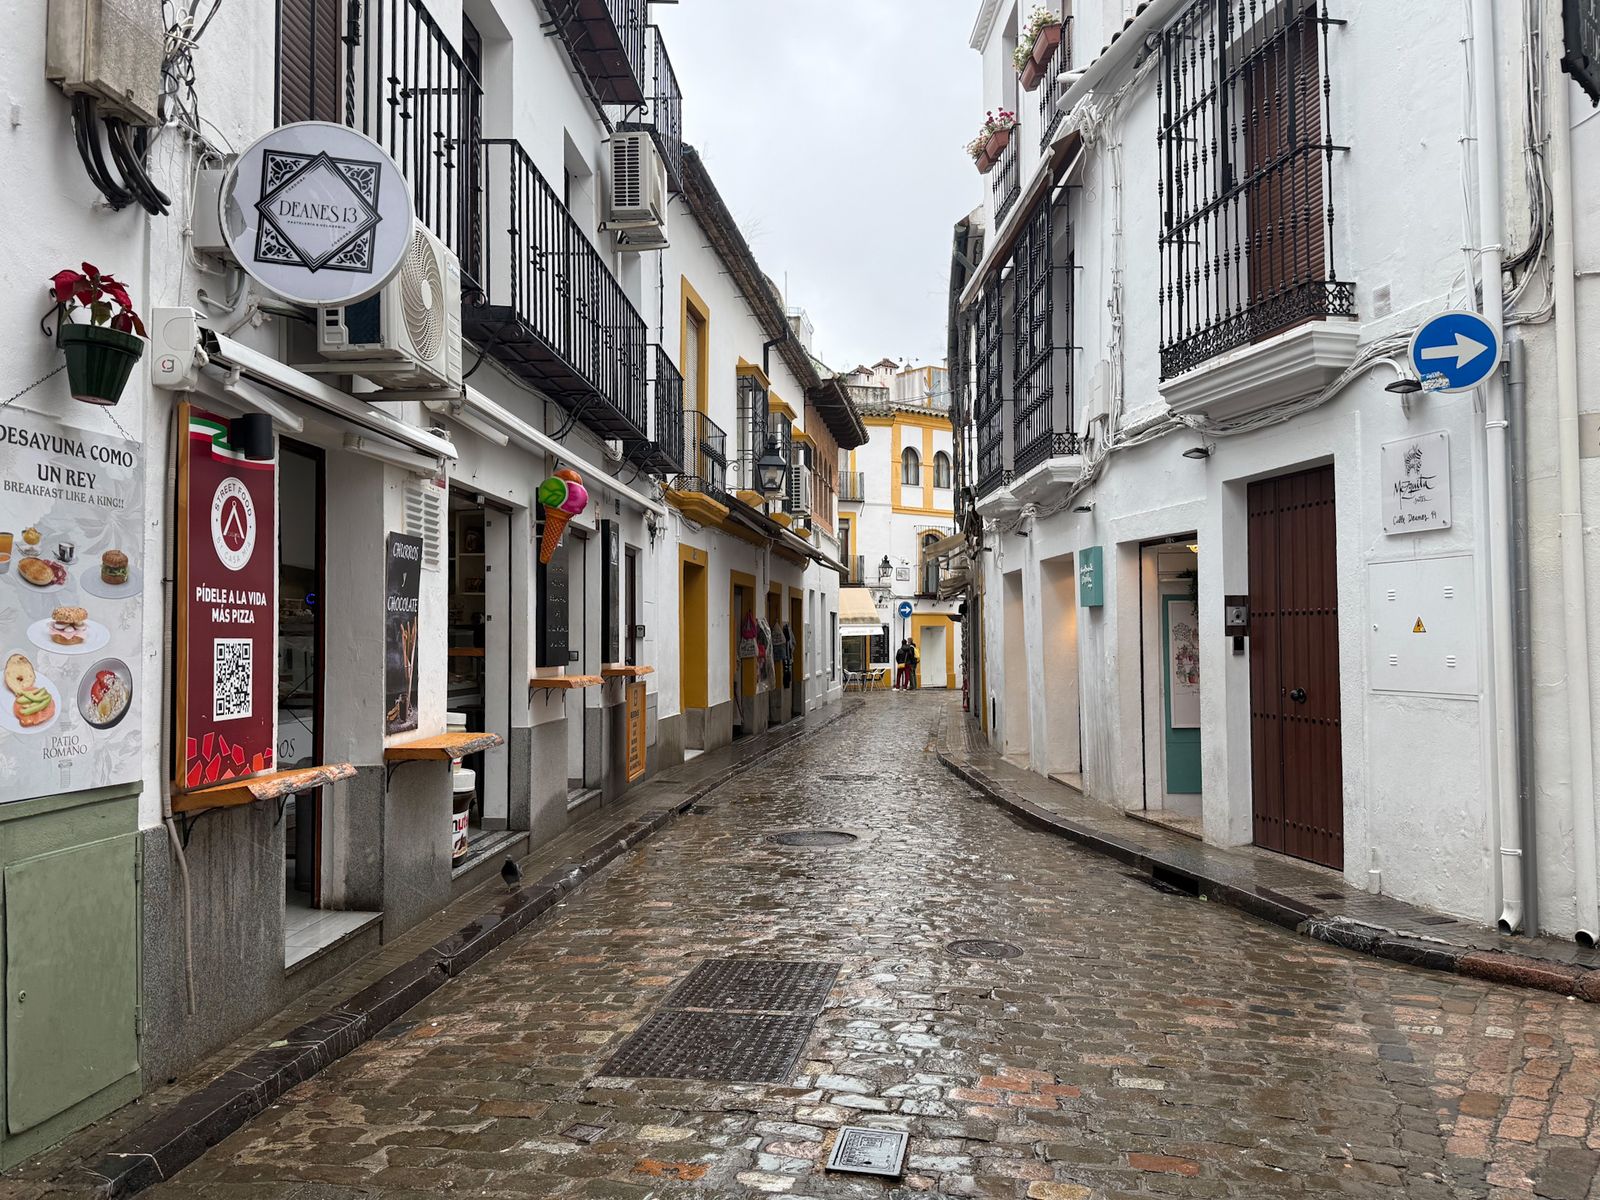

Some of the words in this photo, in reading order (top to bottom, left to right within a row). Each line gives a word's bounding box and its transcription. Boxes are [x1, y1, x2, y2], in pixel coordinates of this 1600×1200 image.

[279, 200, 340, 223] DEANES
[343, 207, 358, 224] 13
[90, 445, 133, 468] COMO
[37, 463, 61, 484] UN
[65, 468, 96, 490] REY
[3, 480, 64, 499] BREAKFAST
[65, 489, 86, 503] LIKE
[88, 494, 96, 505] A
[97, 495, 124, 509] KING!!
[215, 483, 236, 512] STREET
[238, 486, 253, 517] FOOD
[196, 582, 228, 603] PÍDELE
[228, 590, 235, 604] A
[236, 590, 247, 605] LA
[248, 591, 267, 606] VIDA
[212, 604, 230, 623] MÁS
[232, 609, 255, 624] PIZZA
[43, 744, 88, 760] ROMANO
[51, 735, 79, 748] PATIO
